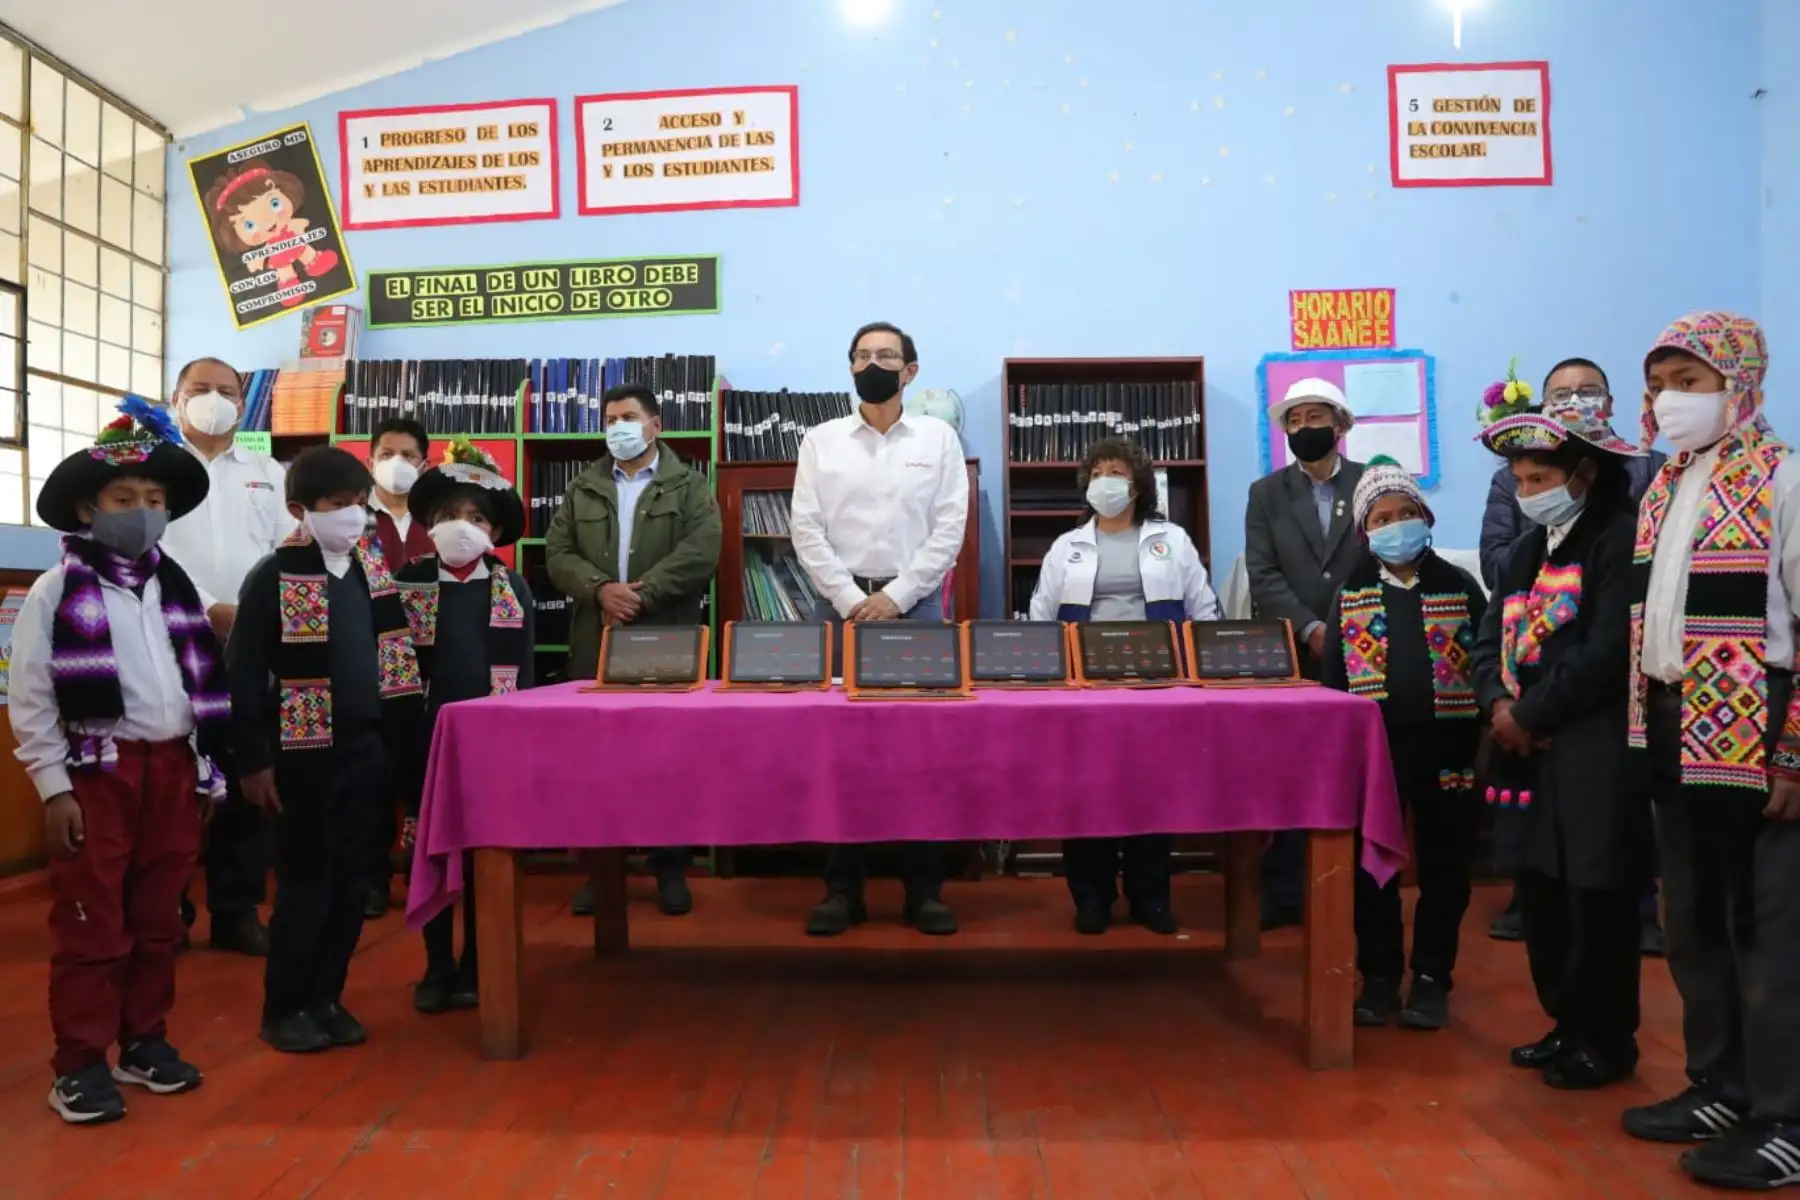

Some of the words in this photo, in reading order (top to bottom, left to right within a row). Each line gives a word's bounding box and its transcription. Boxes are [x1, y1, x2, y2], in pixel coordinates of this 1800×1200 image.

[1408, 99, 1419, 112] 5
[1433, 95, 1500, 112] GESTIÓN
[1513, 99, 1536, 112] DE
[603, 118, 613, 131] 2
[660, 112, 722, 129] ACCESO
[733, 111, 744, 126] Y
[1408, 122, 1426, 135] LA
[1431, 121, 1537, 135] CONVIVENCIA
[229, 141, 280, 162] ASEGURO
[285, 133, 305, 144] MIS
[361, 137, 368, 149] 1
[381, 128, 466, 147] PROGRESO
[477, 125, 498, 140] DE
[508, 123, 538, 138] LOS
[602, 135, 712, 157] PERMANENCIA
[719, 134, 740, 148] DE
[746, 131, 775, 146] LAS
[363, 154, 477, 172] APRENDIZAJES
[482, 153, 504, 168] DE
[509, 151, 539, 166] LOS
[1409, 143, 1487, 158] ESCOLAR.
[603, 164, 613, 179] Y
[623, 163, 653, 178] LOS
[664, 157, 775, 177] ESTUDIANTES.
[364, 184, 375, 198] Y
[382, 182, 410, 196] LAS
[244, 229, 325, 262] APRENDIZAJES
[231, 280, 254, 292] CON
[257, 272, 277, 285] LOS
[388, 280, 409, 295] EL
[416, 276, 476, 294] FINAL
[488, 273, 513, 290] DE
[525, 271, 558, 288] UN
[572, 267, 634, 286] LIBRO
[646, 266, 696, 283] DEBE
[239, 282, 314, 312] COMPROMISOS
[413, 301, 450, 317] SER
[462, 298, 482, 314] EL
[493, 294, 562, 313] INICIO
[573, 293, 598, 308] DE
[609, 290, 670, 308] OTRO
[1293, 291, 1391, 320] HORARIO
[1294, 319, 1390, 347] SAANEE
